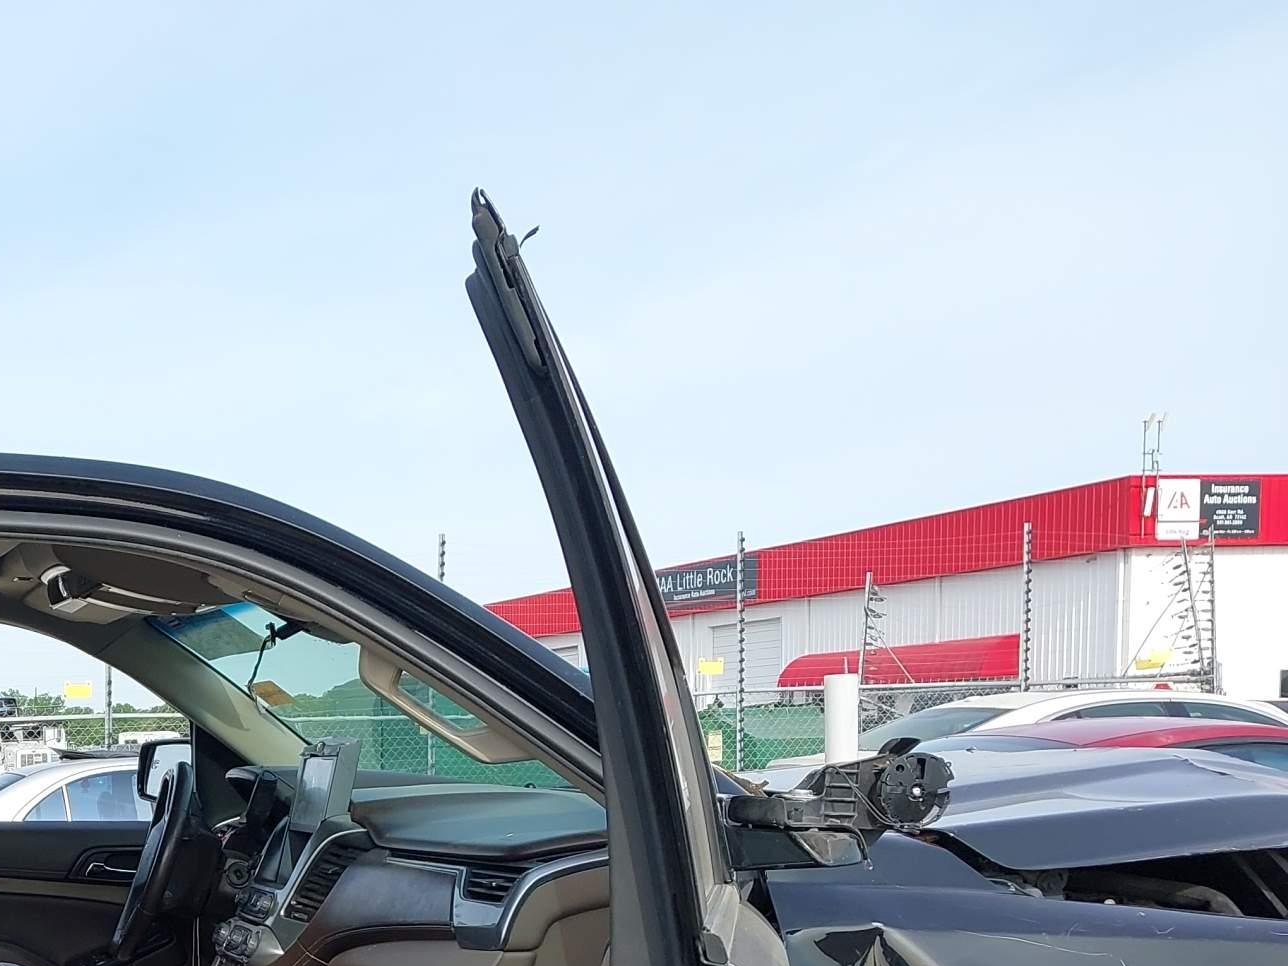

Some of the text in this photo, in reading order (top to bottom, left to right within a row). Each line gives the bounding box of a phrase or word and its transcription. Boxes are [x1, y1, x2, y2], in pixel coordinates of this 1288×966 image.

[1211, 483, 1250, 494] Insurance
[1203, 493, 1257, 505] Auto Auctions
[676, 570, 703, 591] Little
[706, 563, 734, 586] Rock
